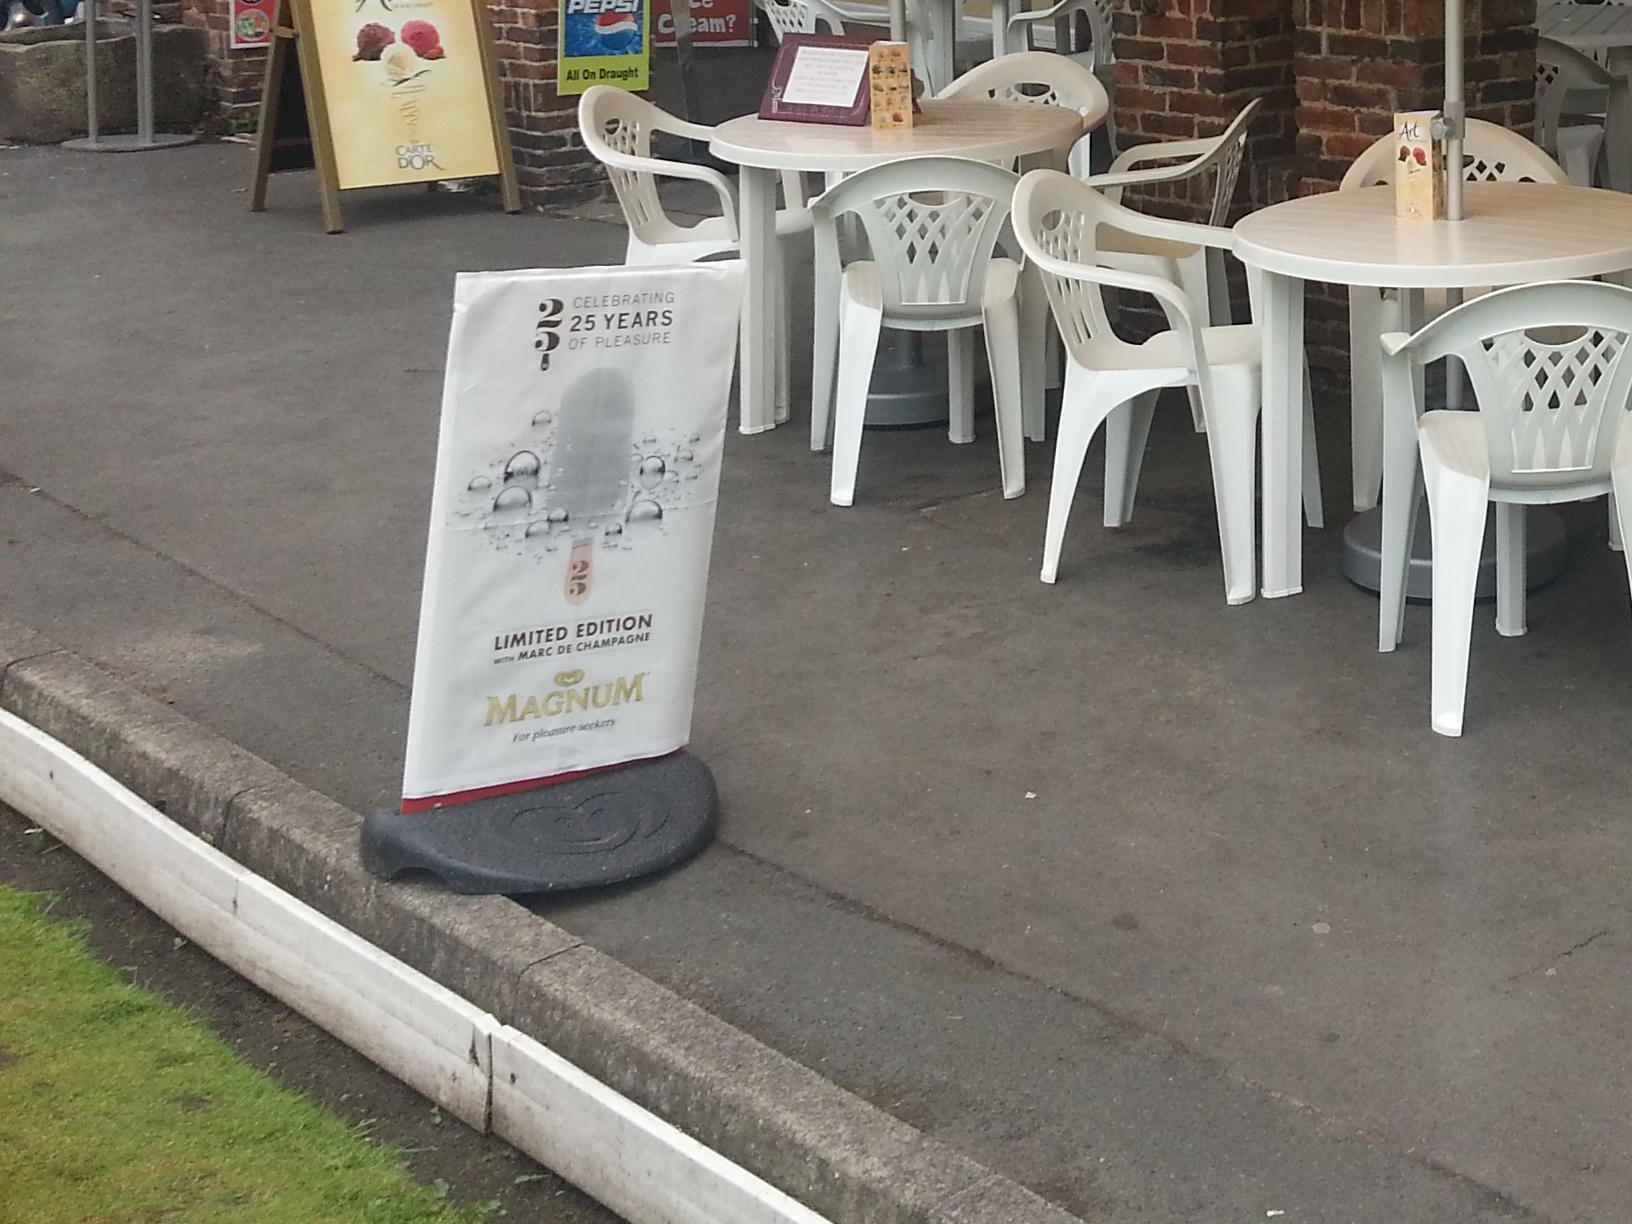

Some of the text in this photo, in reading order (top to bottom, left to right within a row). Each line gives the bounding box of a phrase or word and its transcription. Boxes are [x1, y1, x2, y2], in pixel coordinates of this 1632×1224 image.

[657, 13, 737, 34] Ceam?
[566, 68, 639, 82] All On Draught
[1398, 120, 1420, 142] Art
[395, 143, 434, 157] CARTE
[572, 291, 676, 310] CELEBRATING
[569, 309, 675, 333] 25 YEARS
[568, 331, 672, 351] OF PLEASURE
[493, 614, 653, 652] LIMITED EDITION
[518, 645, 553, 662] MARC
[557, 642, 573, 656] DE
[577, 632, 651, 653] CHAMPAGNE
[483, 672, 646, 727] MAGNUM
[512, 732, 531, 743] For
[532, 726, 576, 742] pleasure
